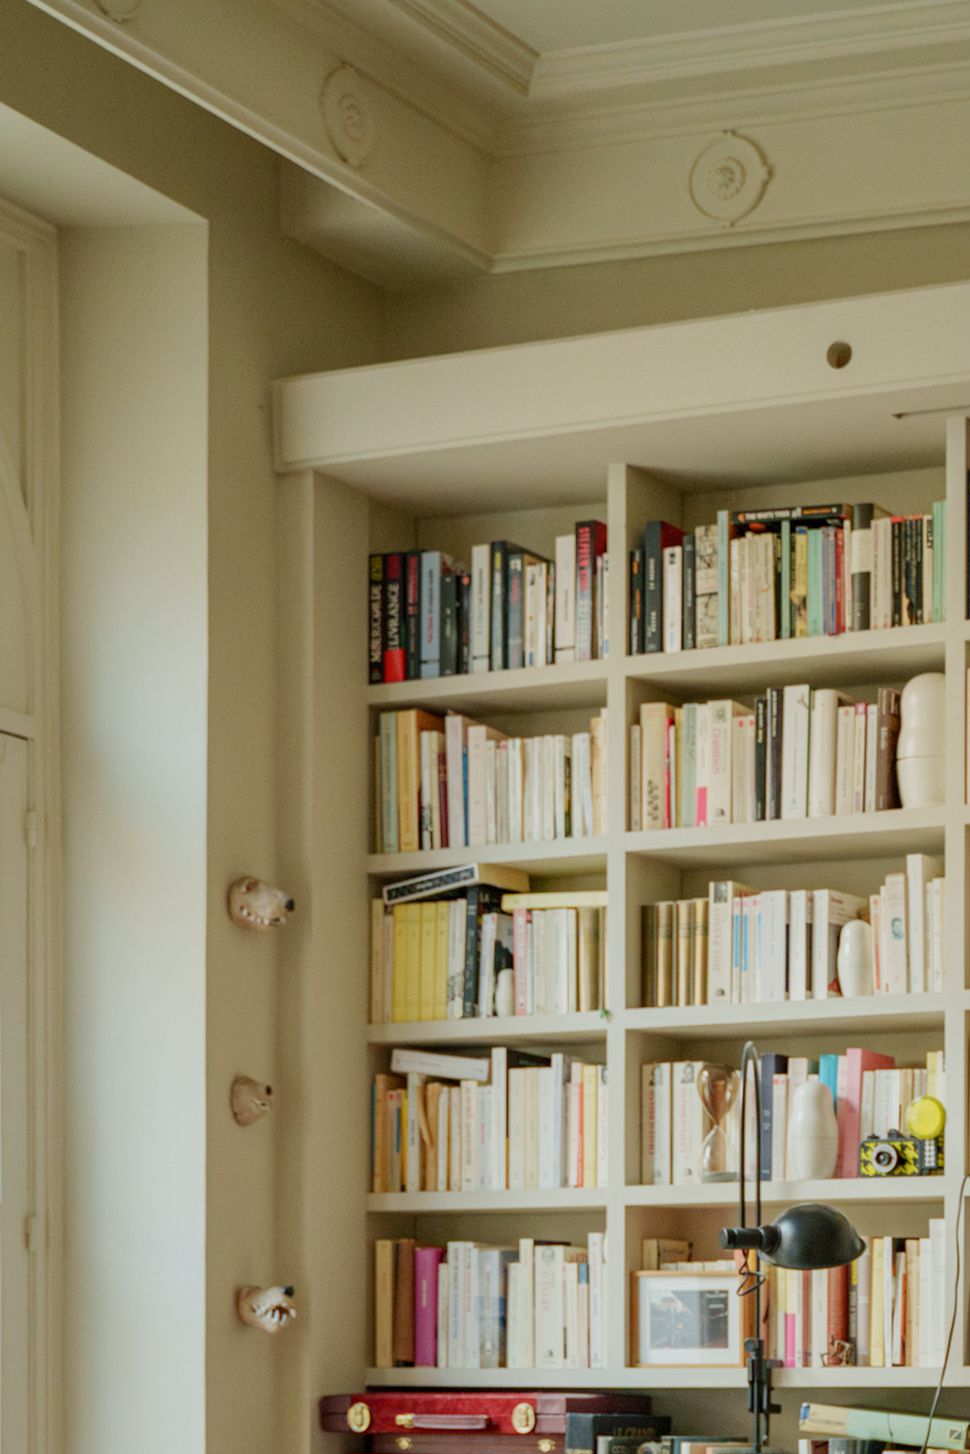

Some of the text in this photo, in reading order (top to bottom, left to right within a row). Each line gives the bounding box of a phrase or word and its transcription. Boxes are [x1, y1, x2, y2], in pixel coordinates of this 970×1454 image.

[578, 527, 590, 566] STEPHEN
[579, 569, 590, 592] KING
[387, 584, 400, 650] LIVRANCE
